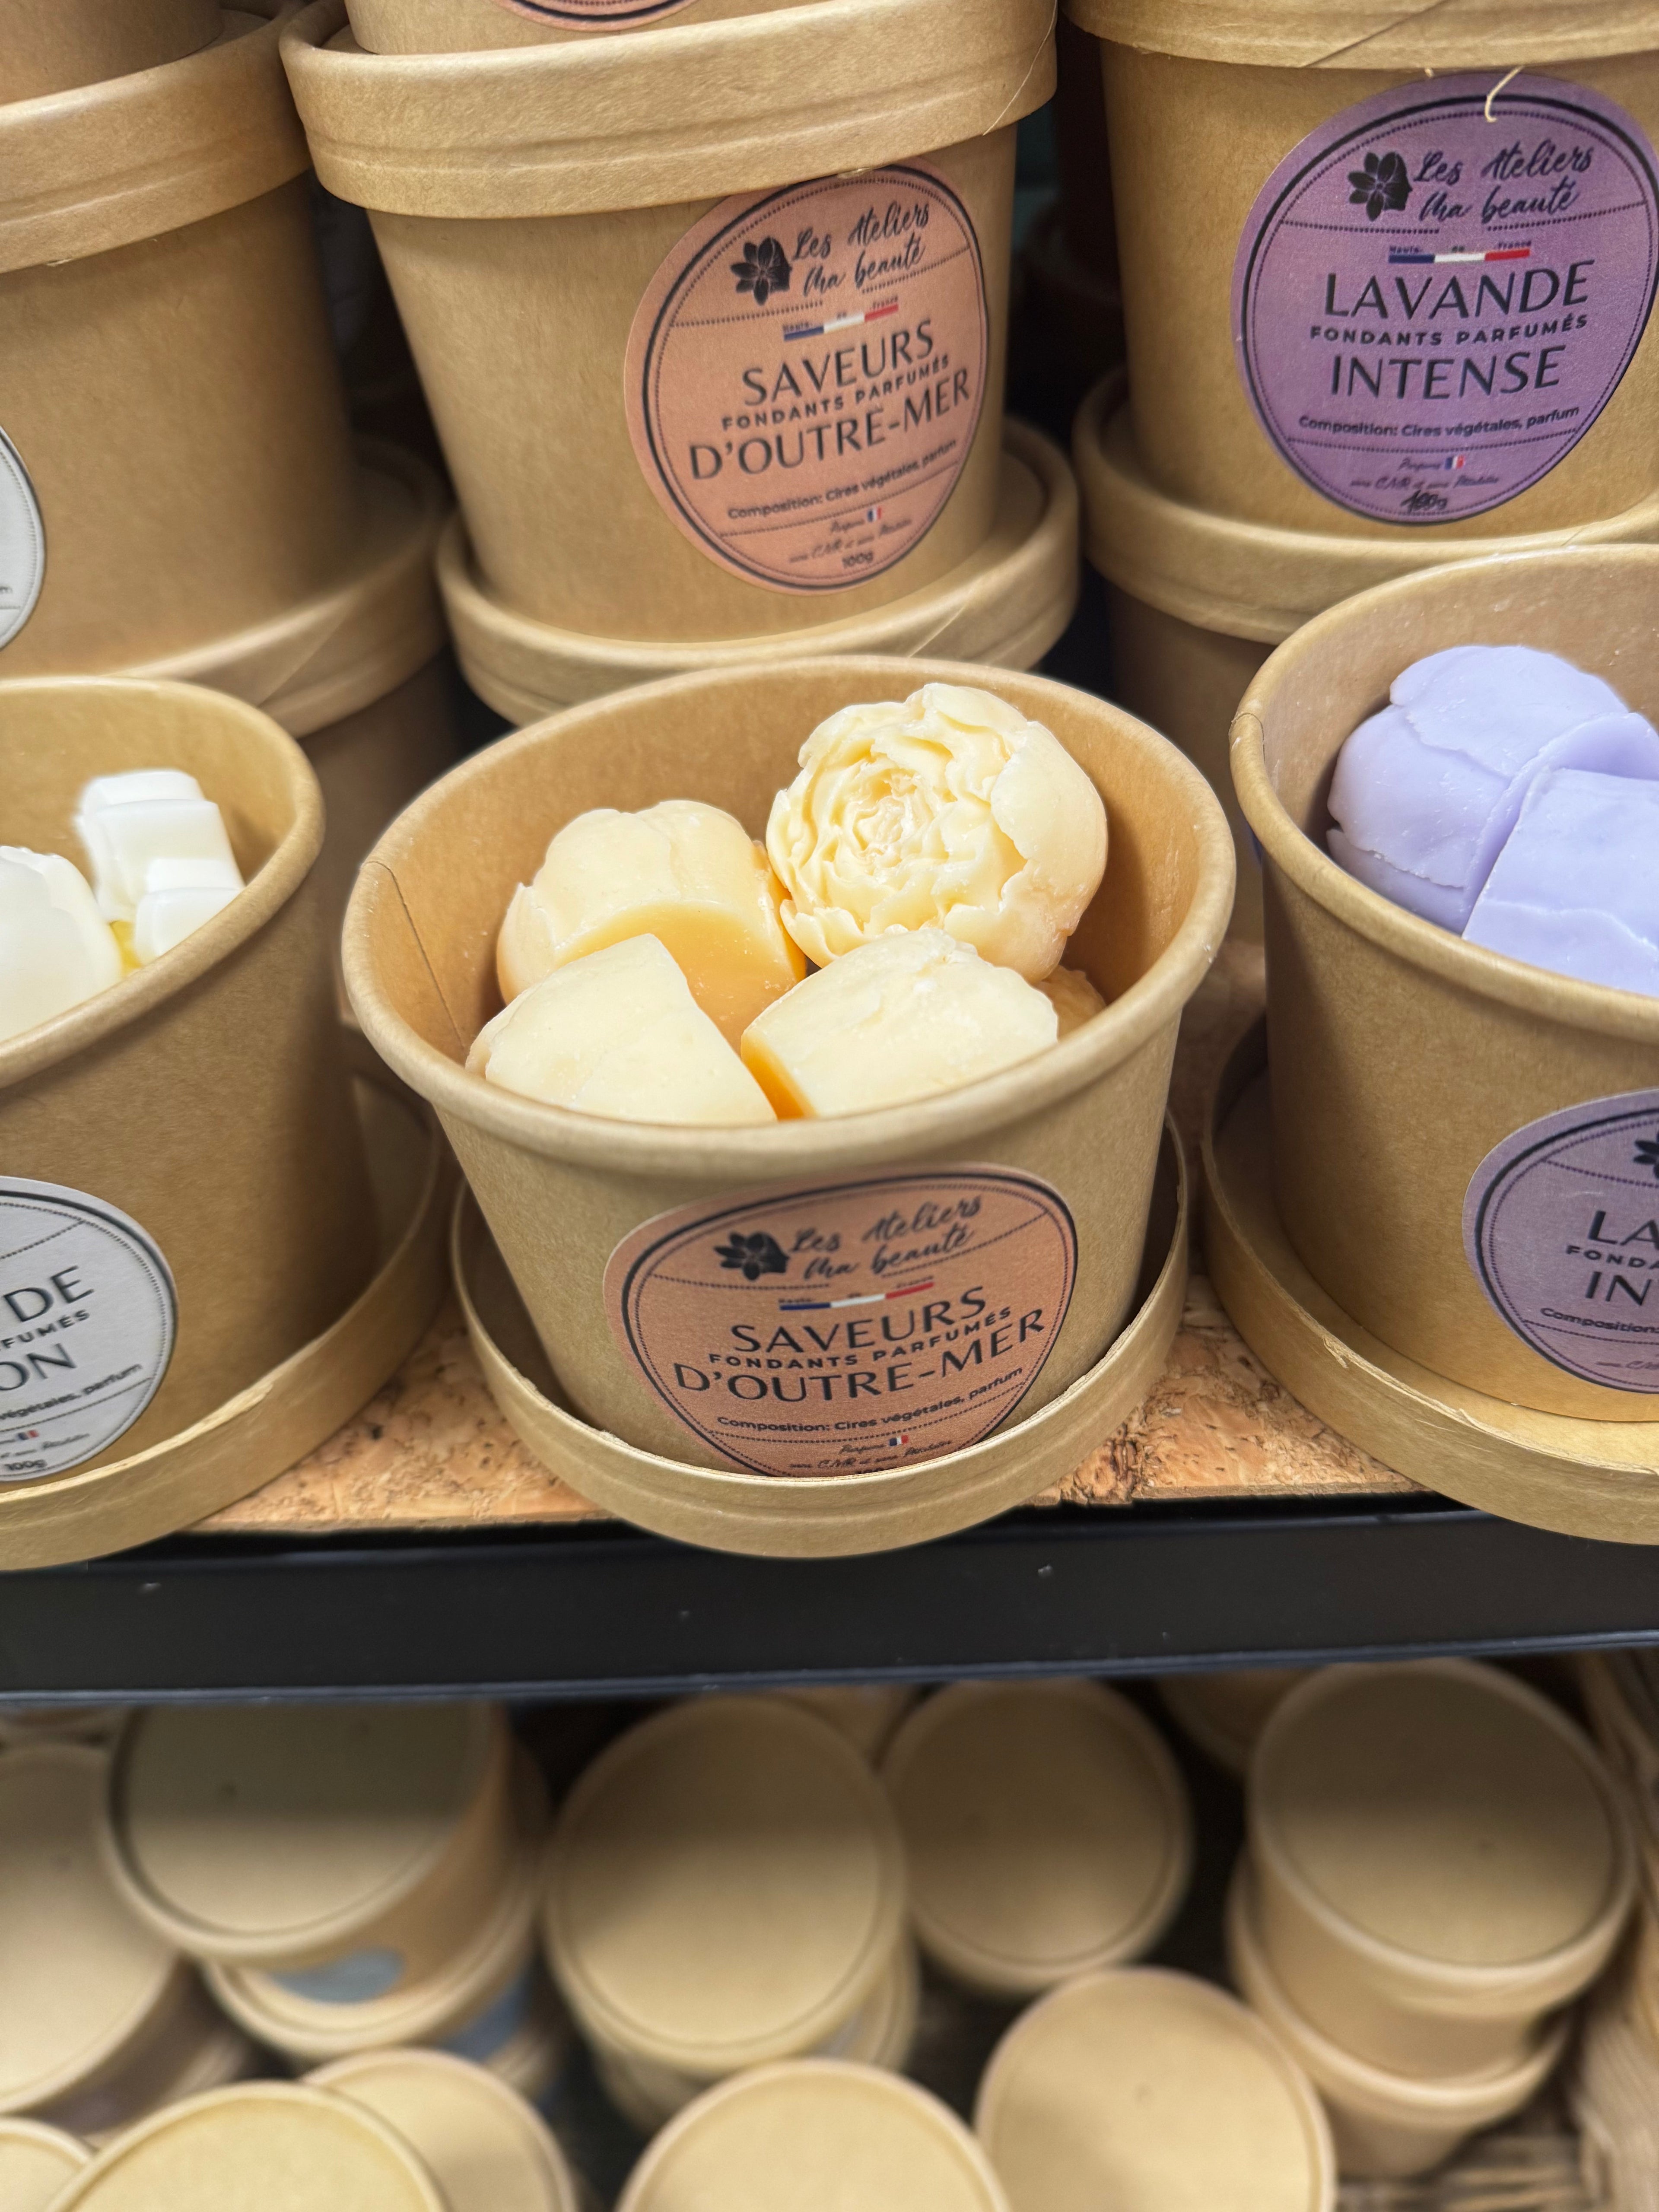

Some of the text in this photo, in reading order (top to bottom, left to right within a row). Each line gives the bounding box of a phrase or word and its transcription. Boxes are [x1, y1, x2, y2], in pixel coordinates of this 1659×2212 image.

[1413, 151, 1463, 186] Les
[1481, 175, 1580, 225] beauté
[792, 226, 832, 260] Les
[855, 231, 926, 290] beauté
[1325, 259, 1595, 320] LAVANDE
[1310, 312, 1588, 346] FONDANTS PARFUMÉS
[742, 320, 933, 406] SAVEURS
[1331, 345, 1566, 400] INTENSE
[721, 353, 949, 431] FONDANTS PARFUMÉS
[1299, 406, 1580, 438] Composition: Cires végétales, parfum
[728, 494, 823, 520] Composition:
[826, 484, 859, 502] Cires
[922, 439, 957, 468] parfum
[789, 1227, 841, 1252] Les
[870, 1221, 974, 1274] beauté
[1588, 1210, 1659, 1250] LA
[3, 1265, 95, 1322] DE
[1585, 1271, 1653, 1306] IN
[709, 1306, 1012, 1370] FONDANTS PARFUMÉS
[731, 1285, 987, 1353] SAVEURS
[82, 1364, 143, 1395] parfum
[717, 1367, 1023, 1433] Composition: Cires végétales, parfum
